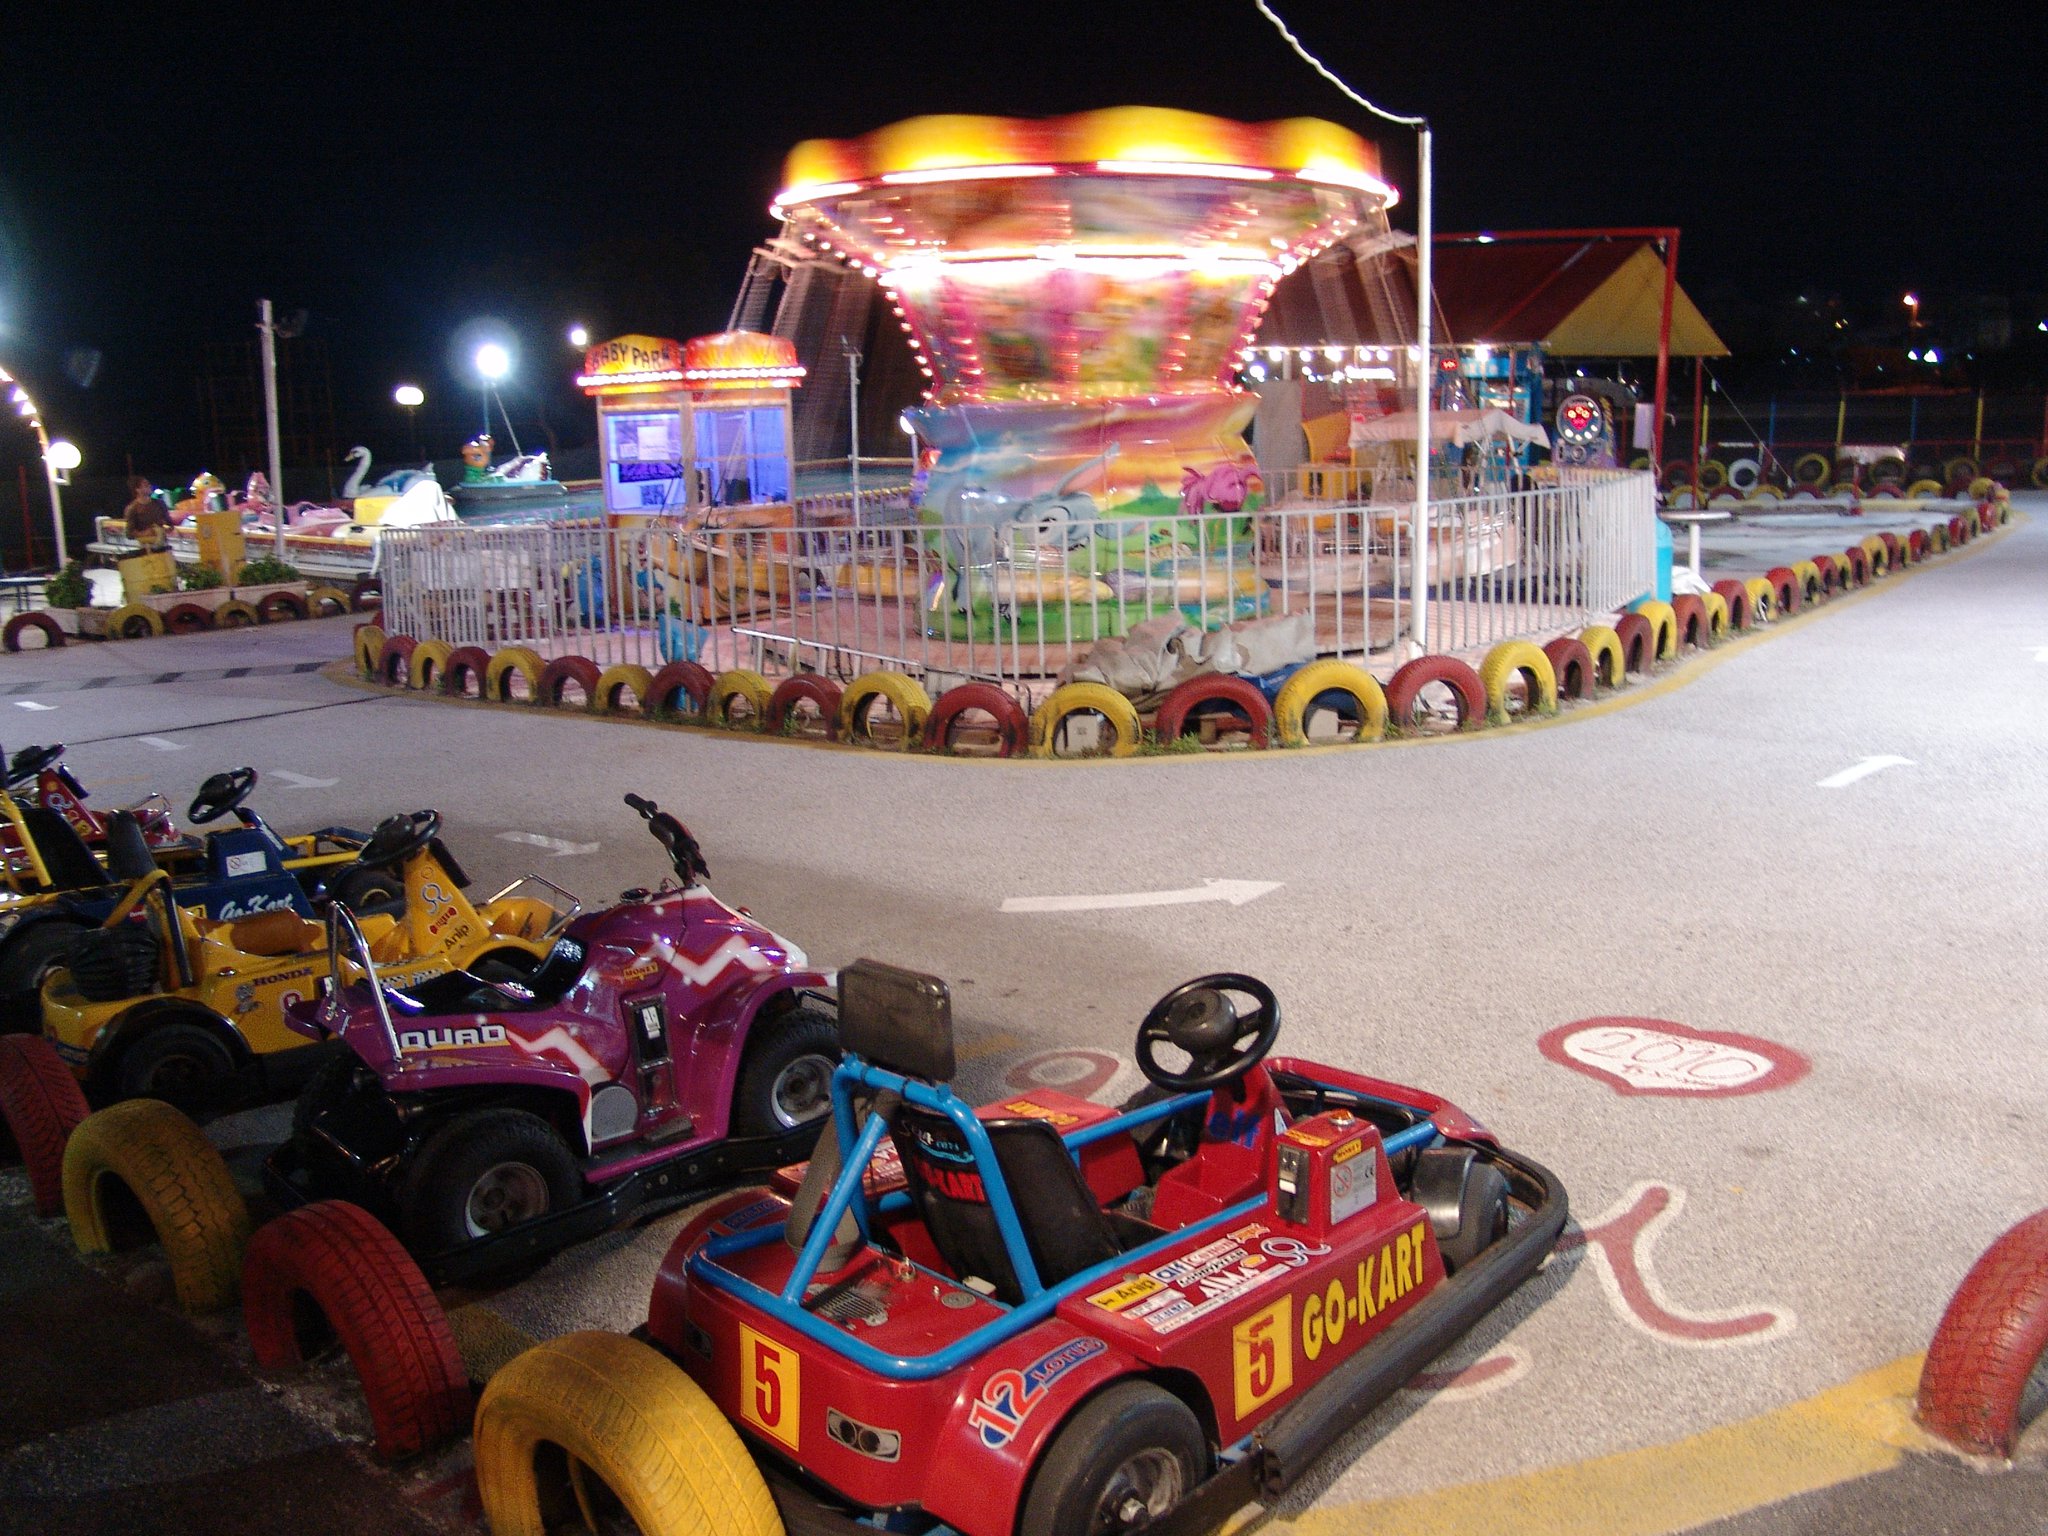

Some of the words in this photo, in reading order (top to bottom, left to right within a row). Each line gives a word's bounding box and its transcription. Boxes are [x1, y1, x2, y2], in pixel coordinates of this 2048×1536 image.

[592, 342, 628, 371] BABY
[401, 1024, 507, 1050] QUAD
[1302, 1220, 1426, 1361] GO-KART
[755, 1340, 781, 1428] 5
[968, 1367, 1049, 1449] 12
[1031, 1337, 1106, 1383] LOTUS
[1249, 1312, 1275, 1398] 5
